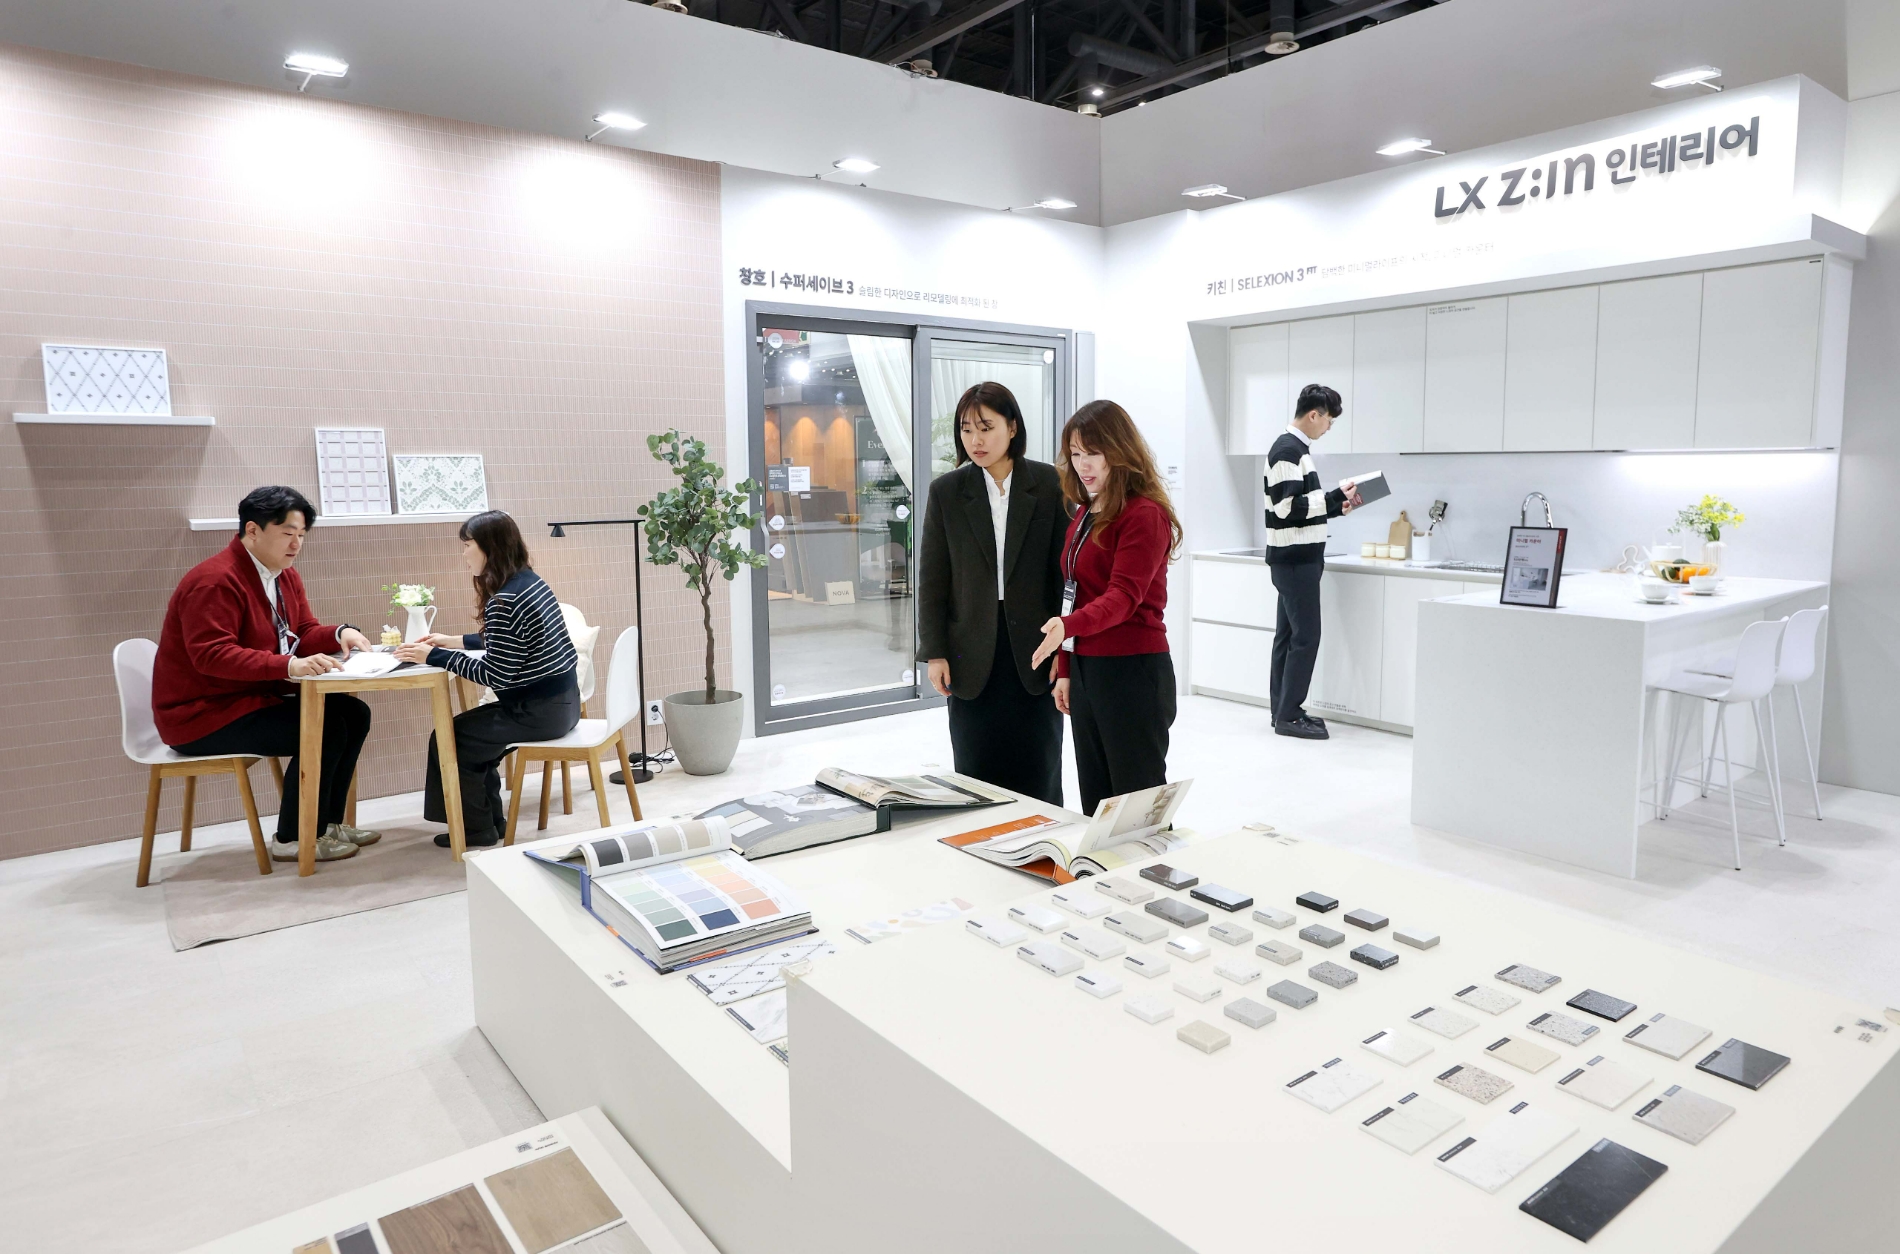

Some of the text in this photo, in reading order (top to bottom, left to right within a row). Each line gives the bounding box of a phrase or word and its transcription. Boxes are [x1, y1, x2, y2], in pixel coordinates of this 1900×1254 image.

[1434, 175, 1489, 218] LX
[1605, 115, 1760, 185] 인테리어
[739, 267, 767, 286] 창호
[780, 272, 844, 294] 수퍼세이브
[846, 280, 854, 295] 3
[859, 286, 882, 298] 슬림한
[884, 288, 921, 301] 디자인으로
[923, 292, 959, 305] 리모델링에
[960, 296, 981, 308] 최적화
[1207, 279, 1227, 296] 키친
[1237, 270, 1294, 291] SELEXION
[1297, 267, 1305, 282] 3
[1321, 264, 1345, 279] 담백한
